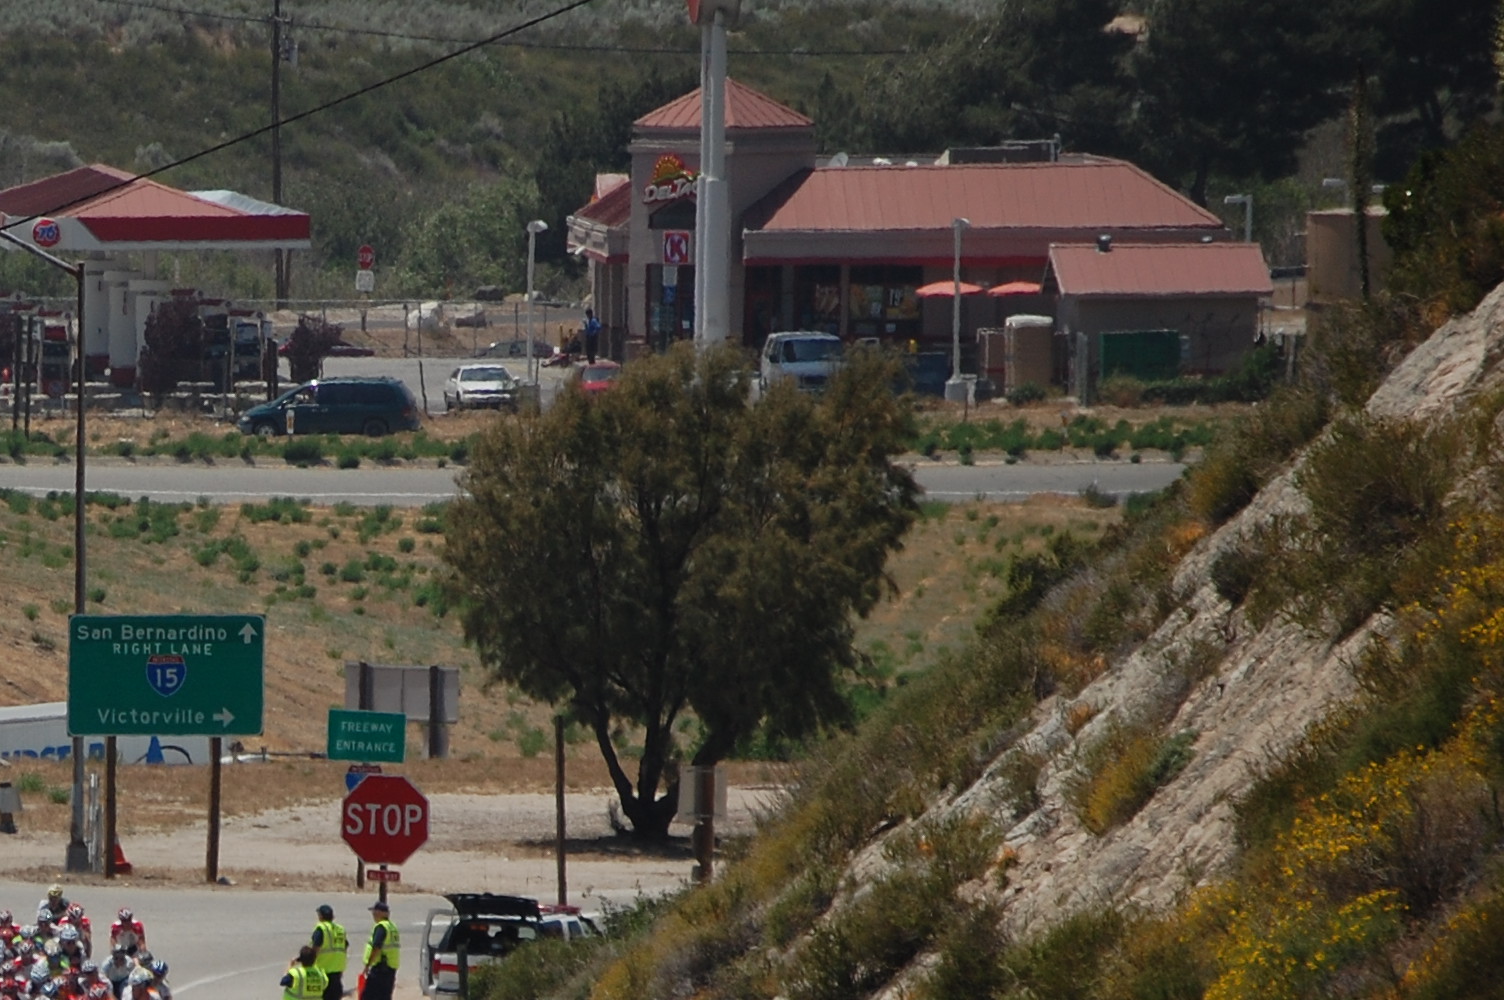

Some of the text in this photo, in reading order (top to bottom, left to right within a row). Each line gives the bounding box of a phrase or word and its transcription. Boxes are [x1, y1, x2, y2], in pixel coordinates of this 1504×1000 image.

[37, 225, 57, 240] 76
[76, 624, 228, 641] San Bernardino
[113, 643, 213, 656] RIGHT LANE
[155, 668, 179, 688] 15
[98, 708, 206, 725] Victorville
[340, 721, 394, 734] FREEWAY
[335, 739, 396, 753] ENTRANCE
[346, 803, 423, 836] STOP
